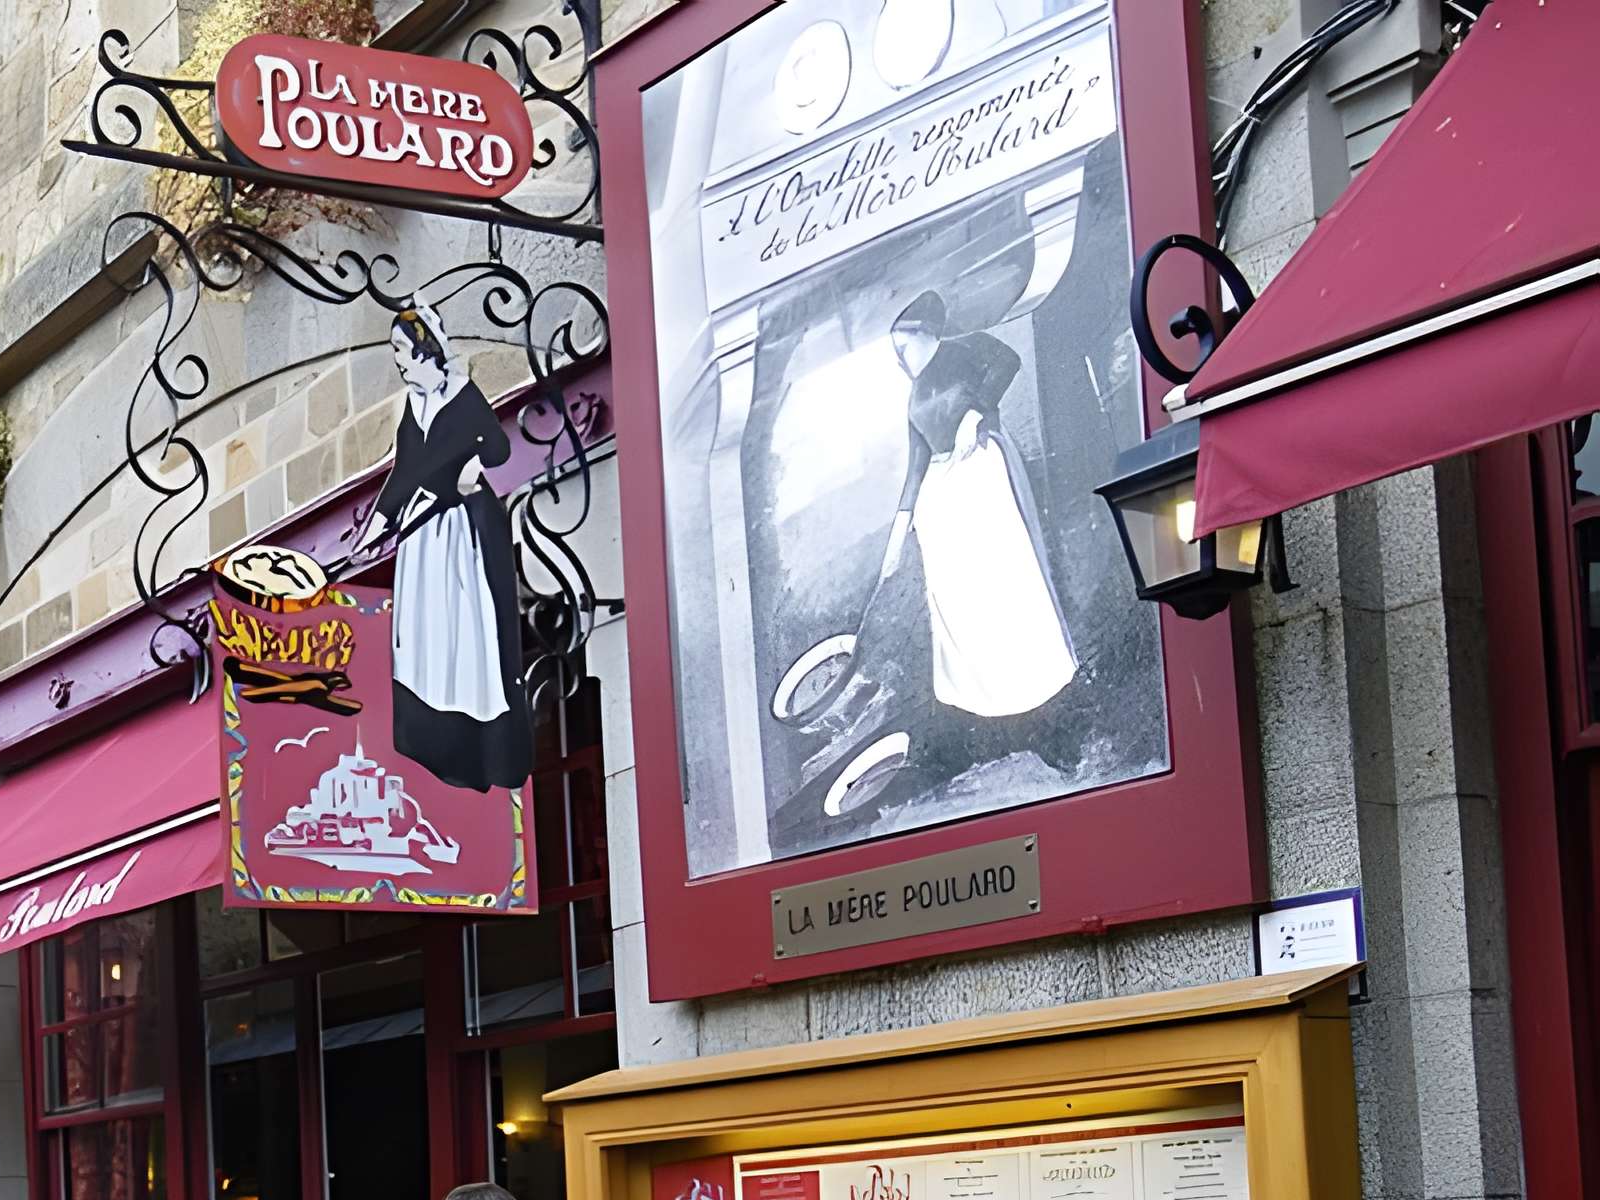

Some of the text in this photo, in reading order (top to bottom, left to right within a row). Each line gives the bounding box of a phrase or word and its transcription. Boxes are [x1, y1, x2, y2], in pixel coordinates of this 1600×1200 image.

[307, 58, 357, 105] LA
[254, 54, 515, 187] POULARD
[787, 906, 816, 936] LA
[902, 864, 1016, 912] POULARD
